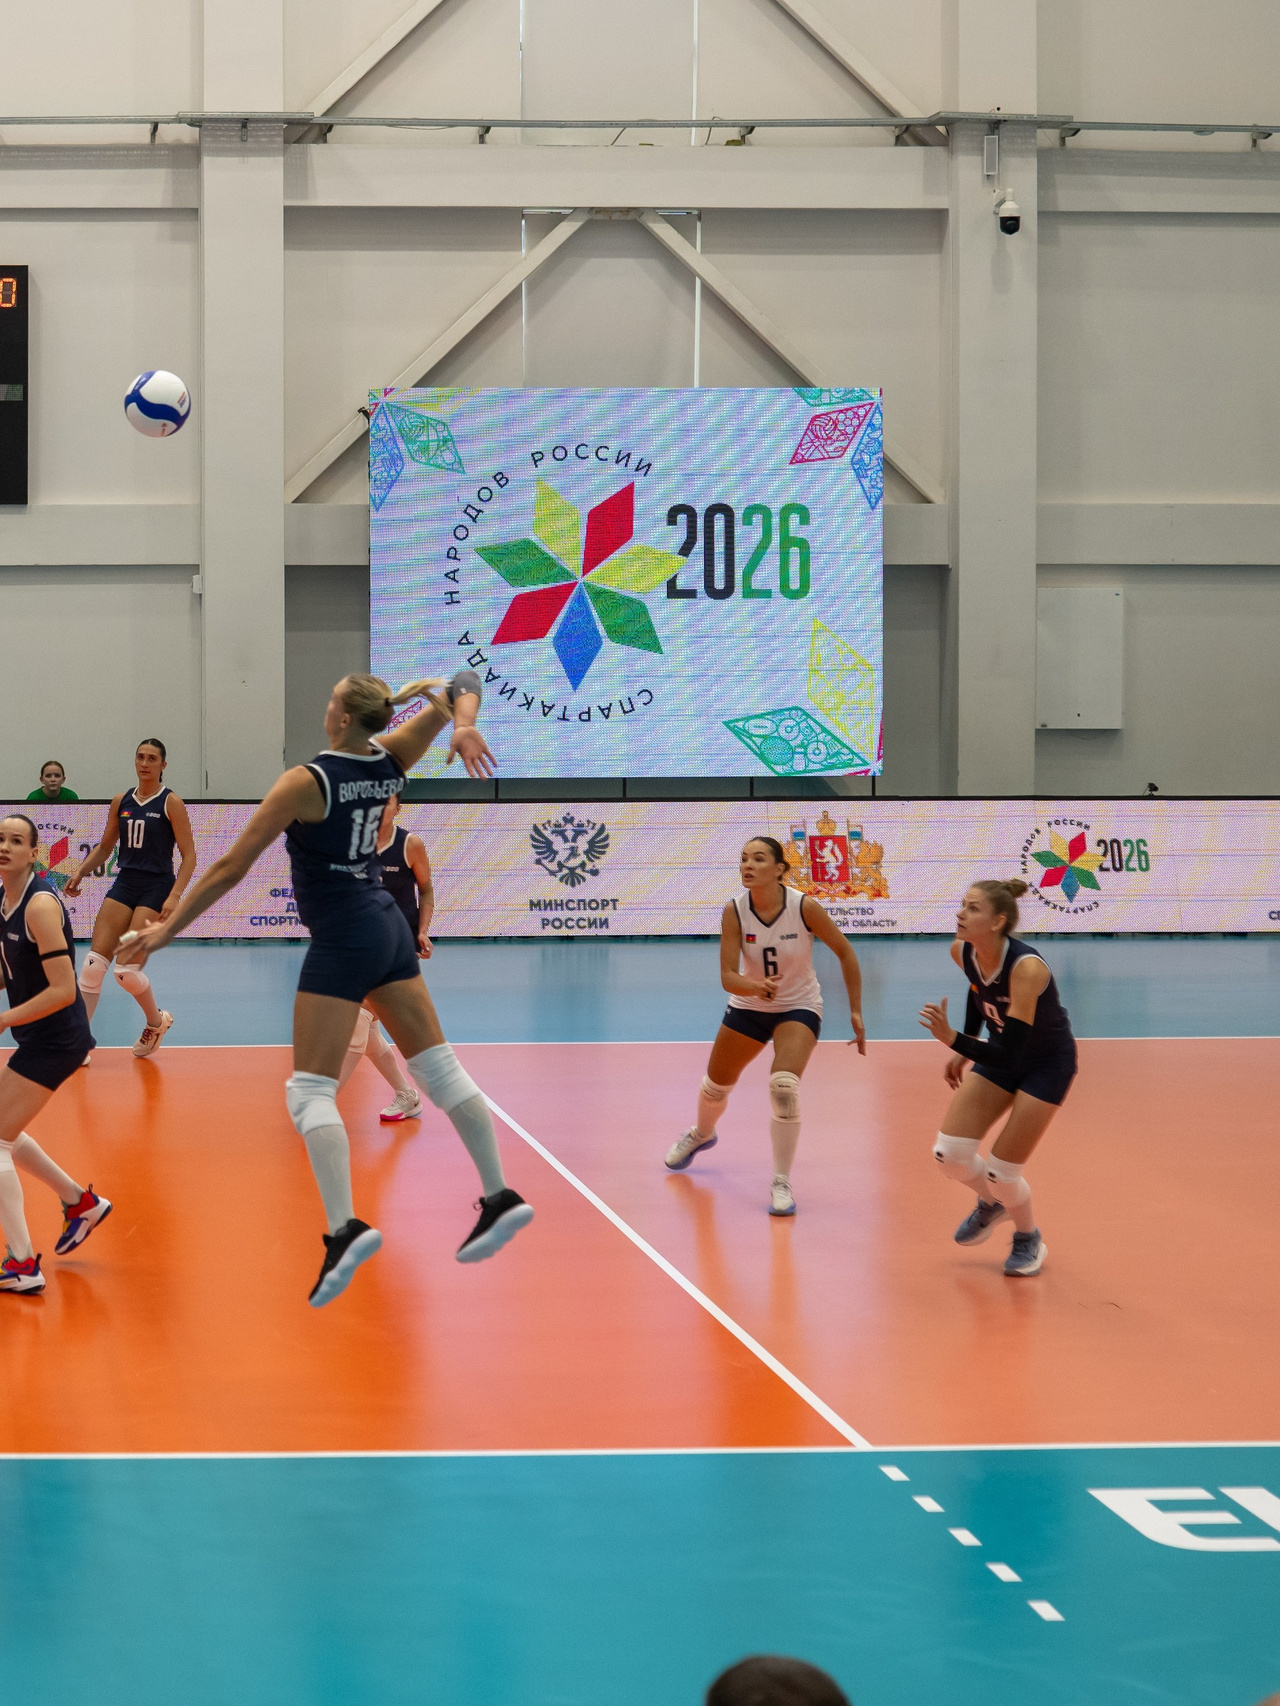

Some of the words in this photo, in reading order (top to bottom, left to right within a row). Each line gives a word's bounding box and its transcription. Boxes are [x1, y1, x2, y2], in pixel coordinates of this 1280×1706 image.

[531, 443, 652, 478] РОССИИ
[444, 471, 510, 605] НАРОДОВ
[666, 503, 812, 600] 2026
[457, 631, 653, 722] СПАРТАКИАДА
[127, 819, 146, 849] 10
[1096, 838, 1151, 873] 2026
[528, 899, 619, 911] МИНСПОРТ
[541, 917, 609, 929] РОССИИ
[763, 947, 778, 978] 6
[1086, 1486, 1280, 1553] E
